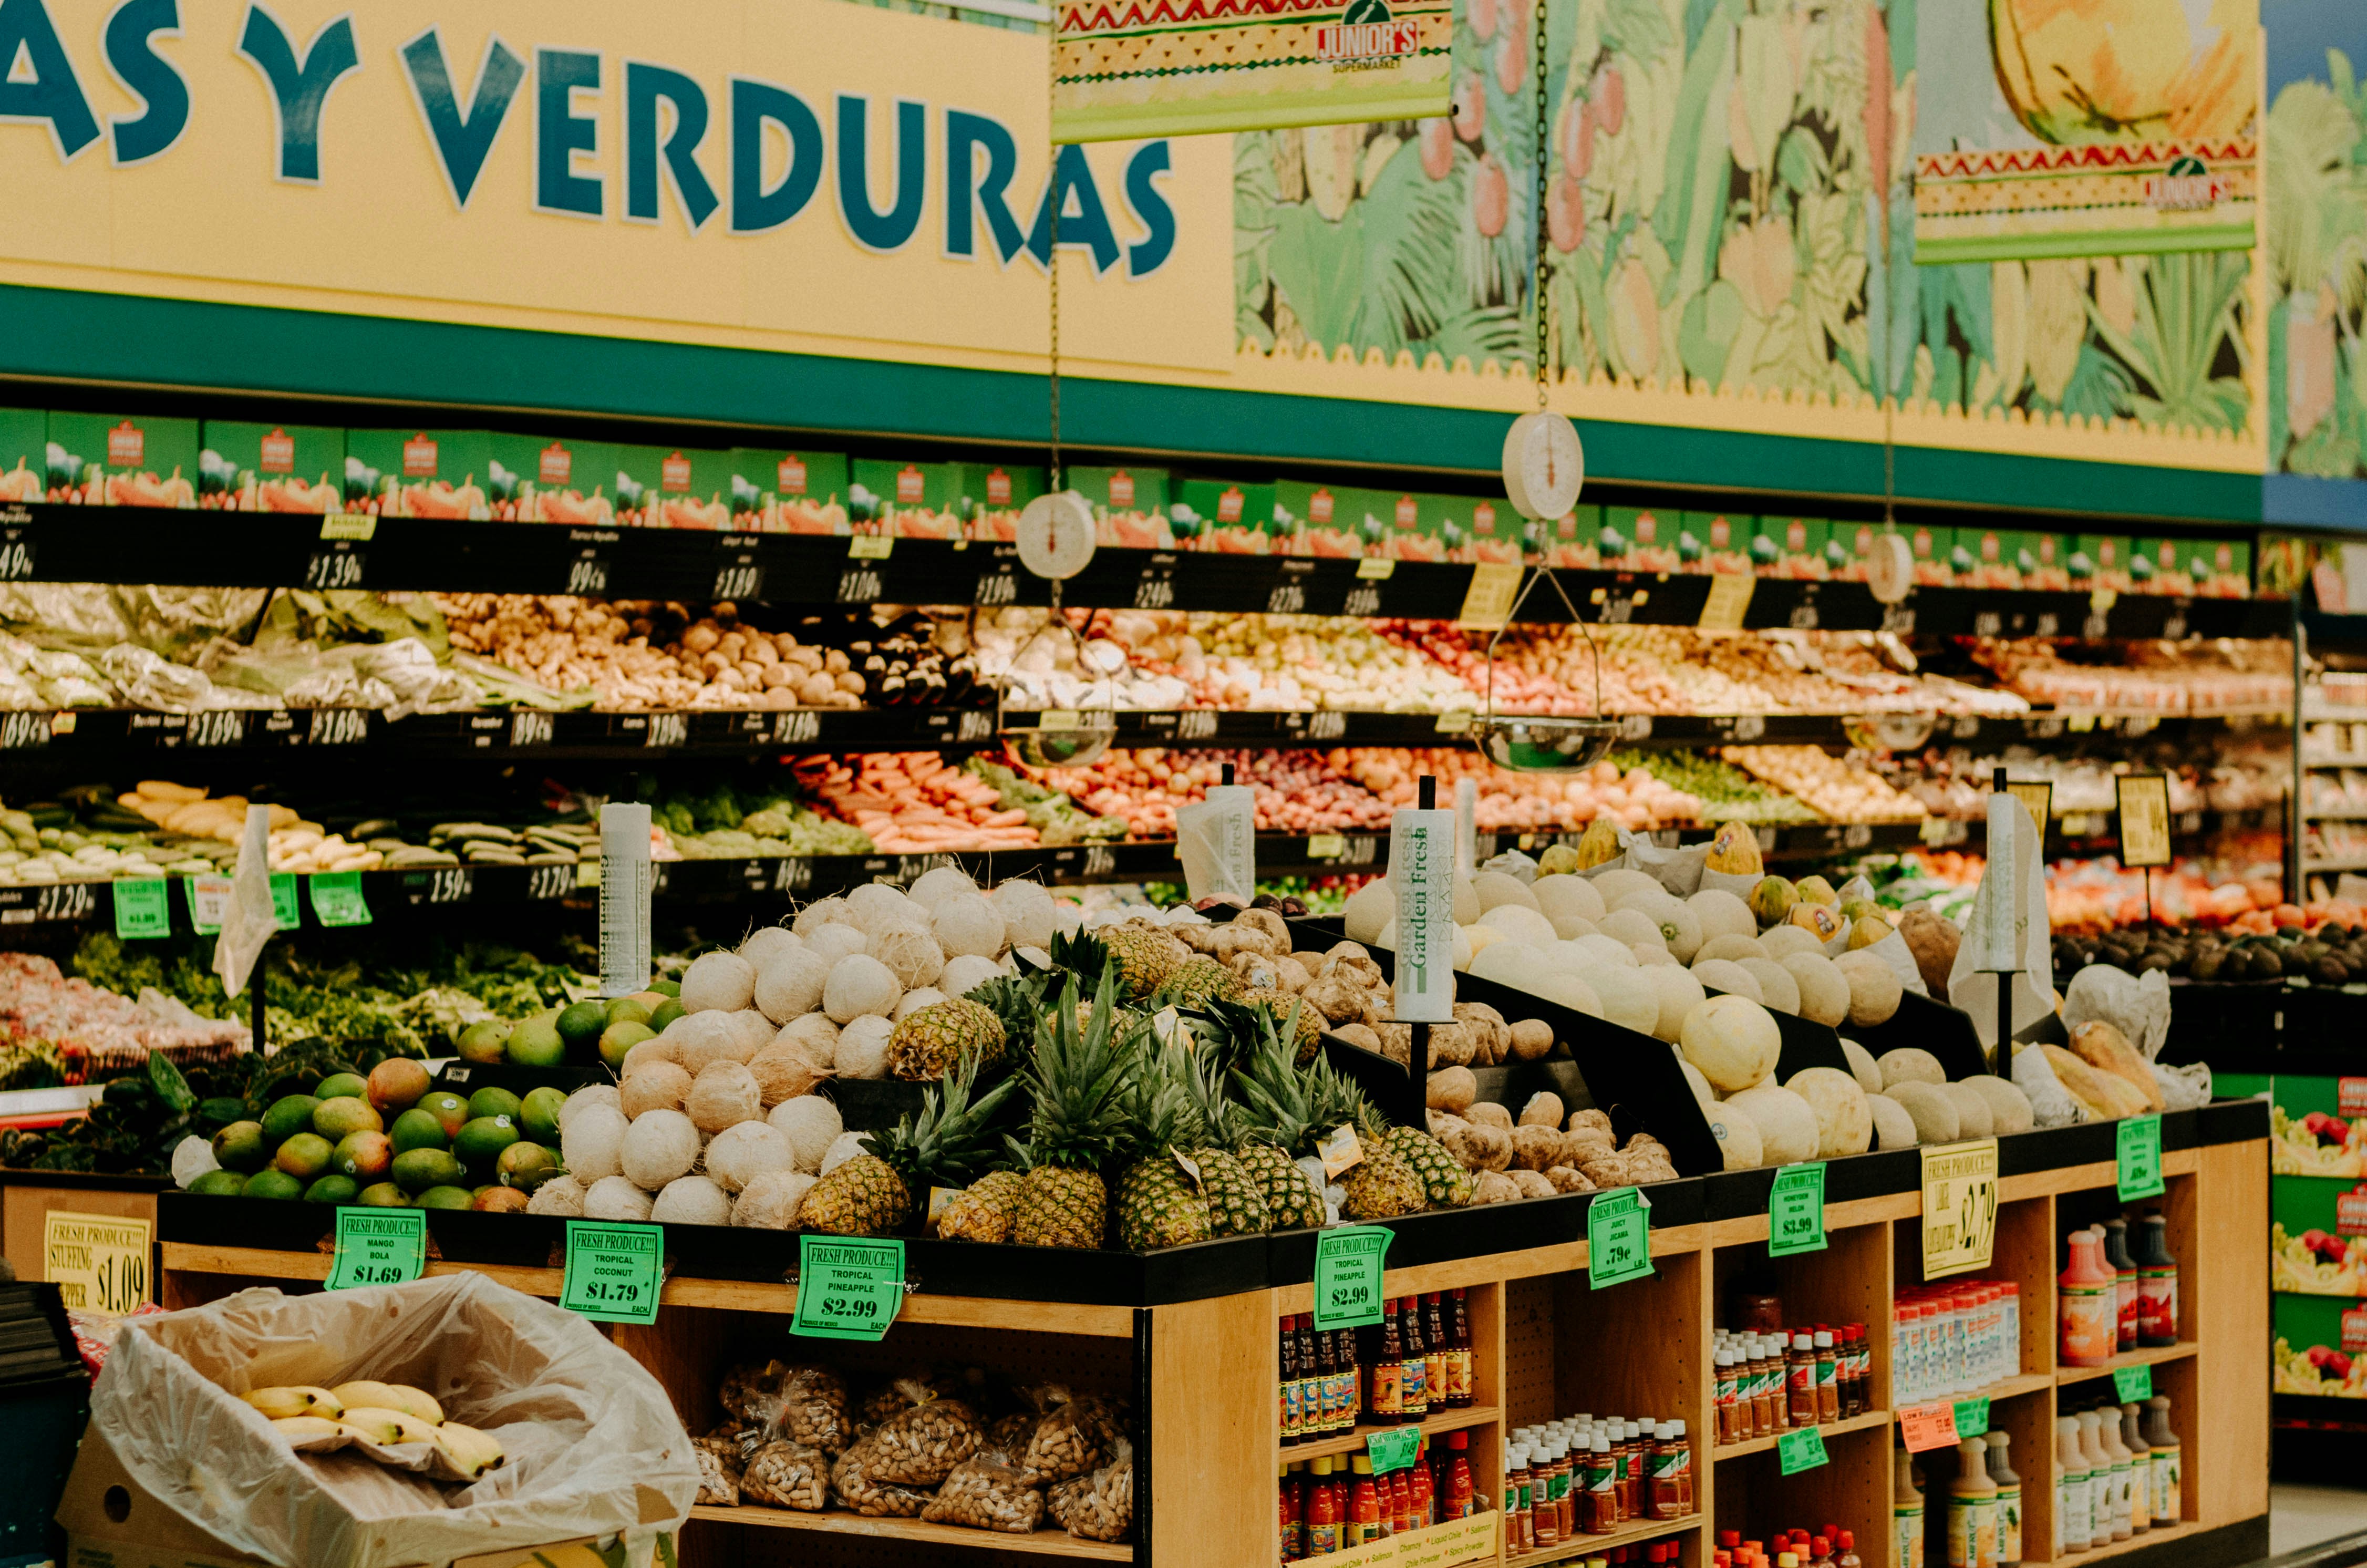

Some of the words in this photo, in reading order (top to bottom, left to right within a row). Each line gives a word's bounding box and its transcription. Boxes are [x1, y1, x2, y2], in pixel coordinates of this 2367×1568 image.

[1318, 22, 1417, 58] JUNIOR'S
[1332, 58, 1401, 73] SUPERMARKET
[234, 0, 364, 186] Y
[396, 24, 1177, 280] VERDURAS
[1410, 827, 1427, 885] Fresh
[600, 854, 609, 924] Garden
[1410, 891, 1427, 968] Garden
[600, 931, 609, 984] Fresh
[1611, 1219, 1626, 1229] JUICY
[1959, 1181, 1995, 1249] $2.79
[53, 1224, 84, 1242] FRESH
[345, 1218, 371, 1233] FRESH
[373, 1220, 419, 1235] PRODUCE!!!
[1609, 1230, 1629, 1241] JICAMA
[1783, 1217, 1812, 1236] $3.99
[367, 1239, 395, 1247] MANGO
[576, 1233, 604, 1249] FRESH
[605, 1234, 655, 1252] PRODUCE!!!
[1321, 1241, 1340, 1256] FRESH
[1342, 1237, 1381, 1254] PRODUCE!!!
[50, 1244, 92, 1271] STUFFING
[595, 1255, 634, 1264] TROPICAL
[811, 1247, 842, 1262] FRESH
[843, 1249, 896, 1266] PRODUCE!!!
[1335, 1259, 1363, 1268] TROPICAL
[353, 1264, 402, 1283] $1.69
[594, 1267, 634, 1277] COCONUT
[831, 1270, 873, 1280] TROPICAL
[1334, 1271, 1365, 1282] PINEAPPLE
[97, 1253, 143, 1313] $1.09
[585, 1281, 638, 1302] $1.79
[828, 1283, 875, 1293] PINEAPPLE
[1331, 1286, 1369, 1307] $2.99
[821, 1297, 877, 1318] $2.99
[1400, 1541, 1421, 1553] Chamoy
[1431, 1534, 1448, 1546] Liquid
[1448, 1531, 1462, 1541] Chile
[1471, 1523, 1492, 1535] Salimon
[1371, 1551, 1393, 1563] Salimon
[1405, 1558, 1419, 1568] Chile
[1420, 1553, 1441, 1566] Powder
[1449, 1546, 1464, 1557] Spicy
[1465, 1540, 1485, 1552] Powder
